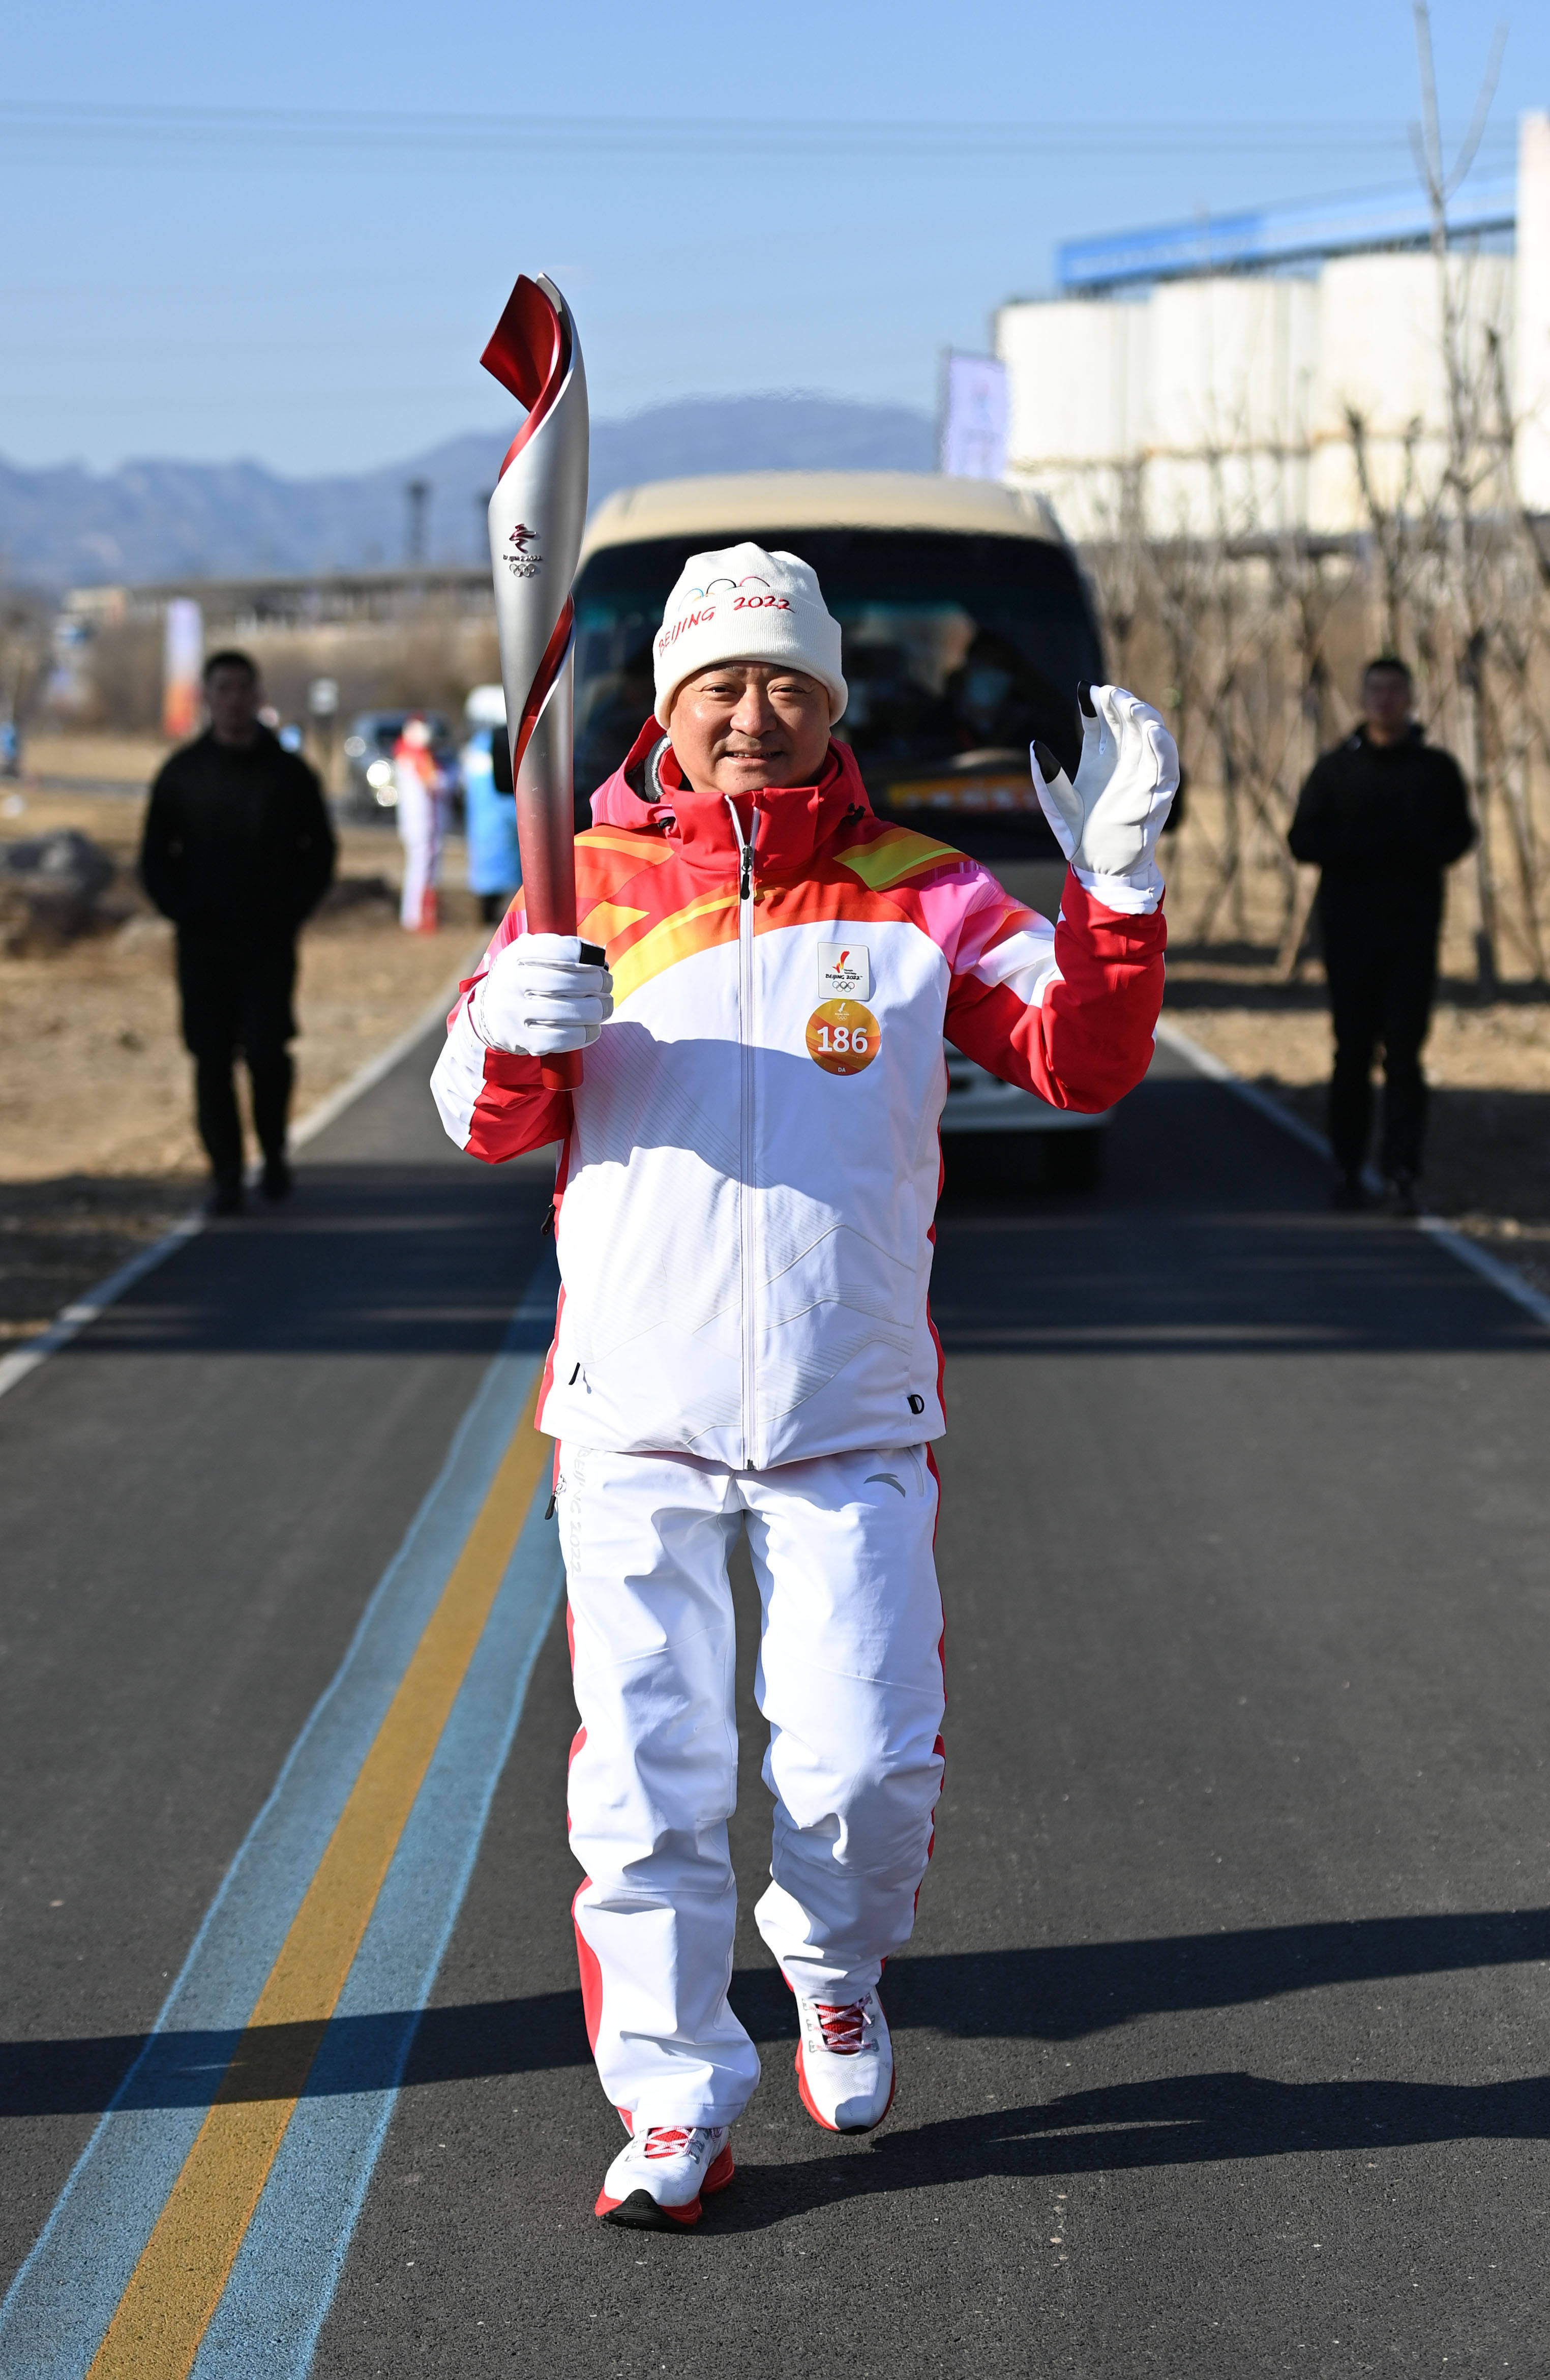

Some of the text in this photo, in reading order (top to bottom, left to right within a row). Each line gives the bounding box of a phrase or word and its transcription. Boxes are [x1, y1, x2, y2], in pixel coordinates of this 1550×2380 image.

[659, 595, 795, 657] BEIJING 2022
[817, 1026, 868, 1053] 186
[570, 1521, 582, 1577] 2022
